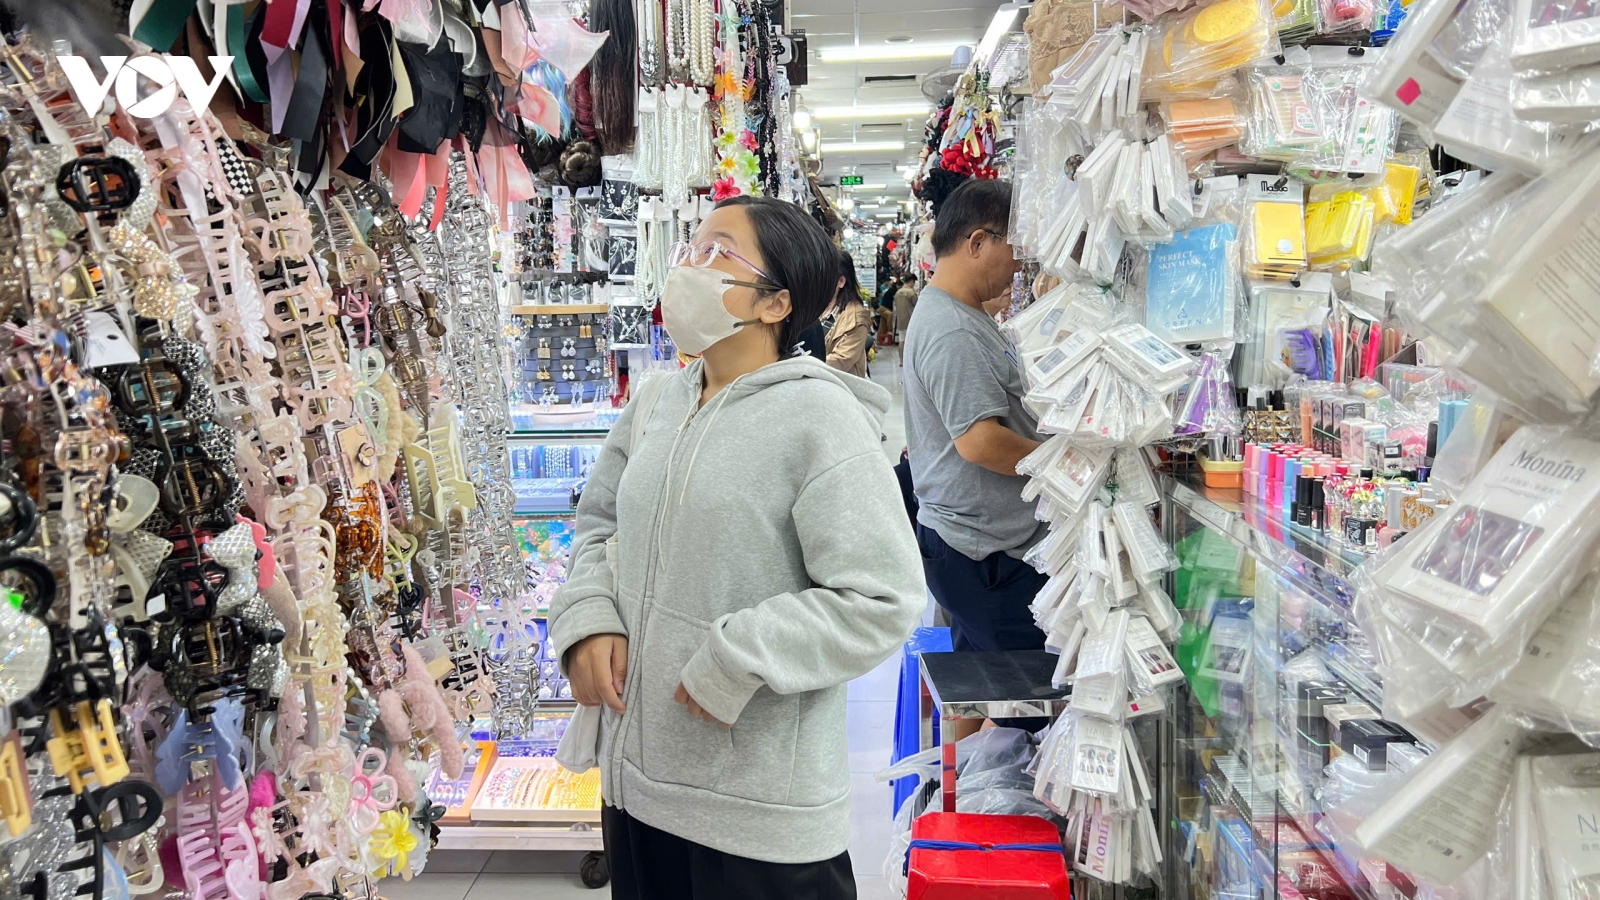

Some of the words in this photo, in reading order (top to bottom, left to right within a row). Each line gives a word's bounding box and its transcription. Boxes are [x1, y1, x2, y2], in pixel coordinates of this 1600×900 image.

[1158, 250, 1194, 262] PERFECT
[1158, 261, 1177, 270] SKIN
[1179, 257, 1201, 268] MASK
[1164, 319, 1202, 328] GREEN
[1086, 726, 1113, 738] NAILS
[1577, 813, 1599, 835] N
